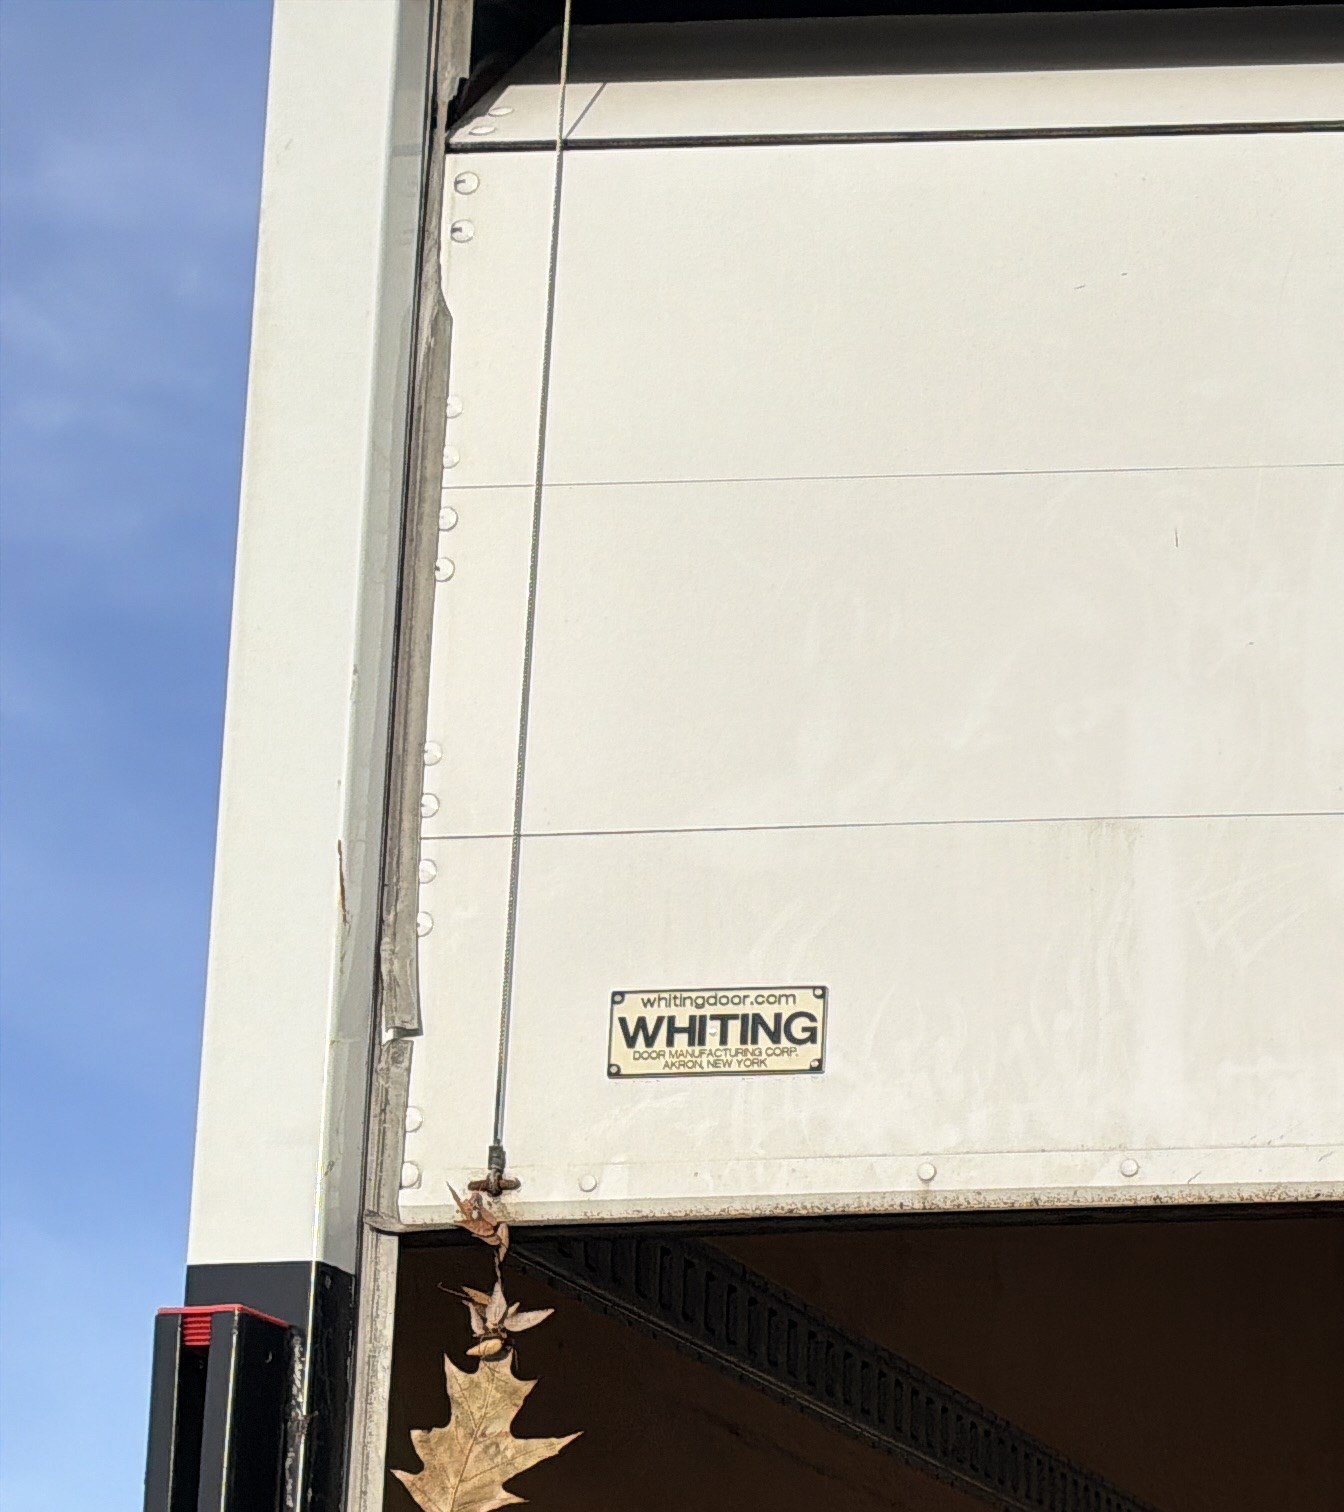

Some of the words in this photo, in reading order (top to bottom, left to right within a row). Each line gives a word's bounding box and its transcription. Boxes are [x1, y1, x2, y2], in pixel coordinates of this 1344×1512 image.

[641, 993, 797, 1010] whitingdoor.com
[617, 1011, 818, 1049] WHITING
[633, 1049, 666, 1061] DOOR
[668, 1047, 763, 1060] MANUFACTURING
[765, 1046, 800, 1058] CORP.
[706, 1058, 734, 1069] NEW
[736, 1057, 768, 1068] YORK
